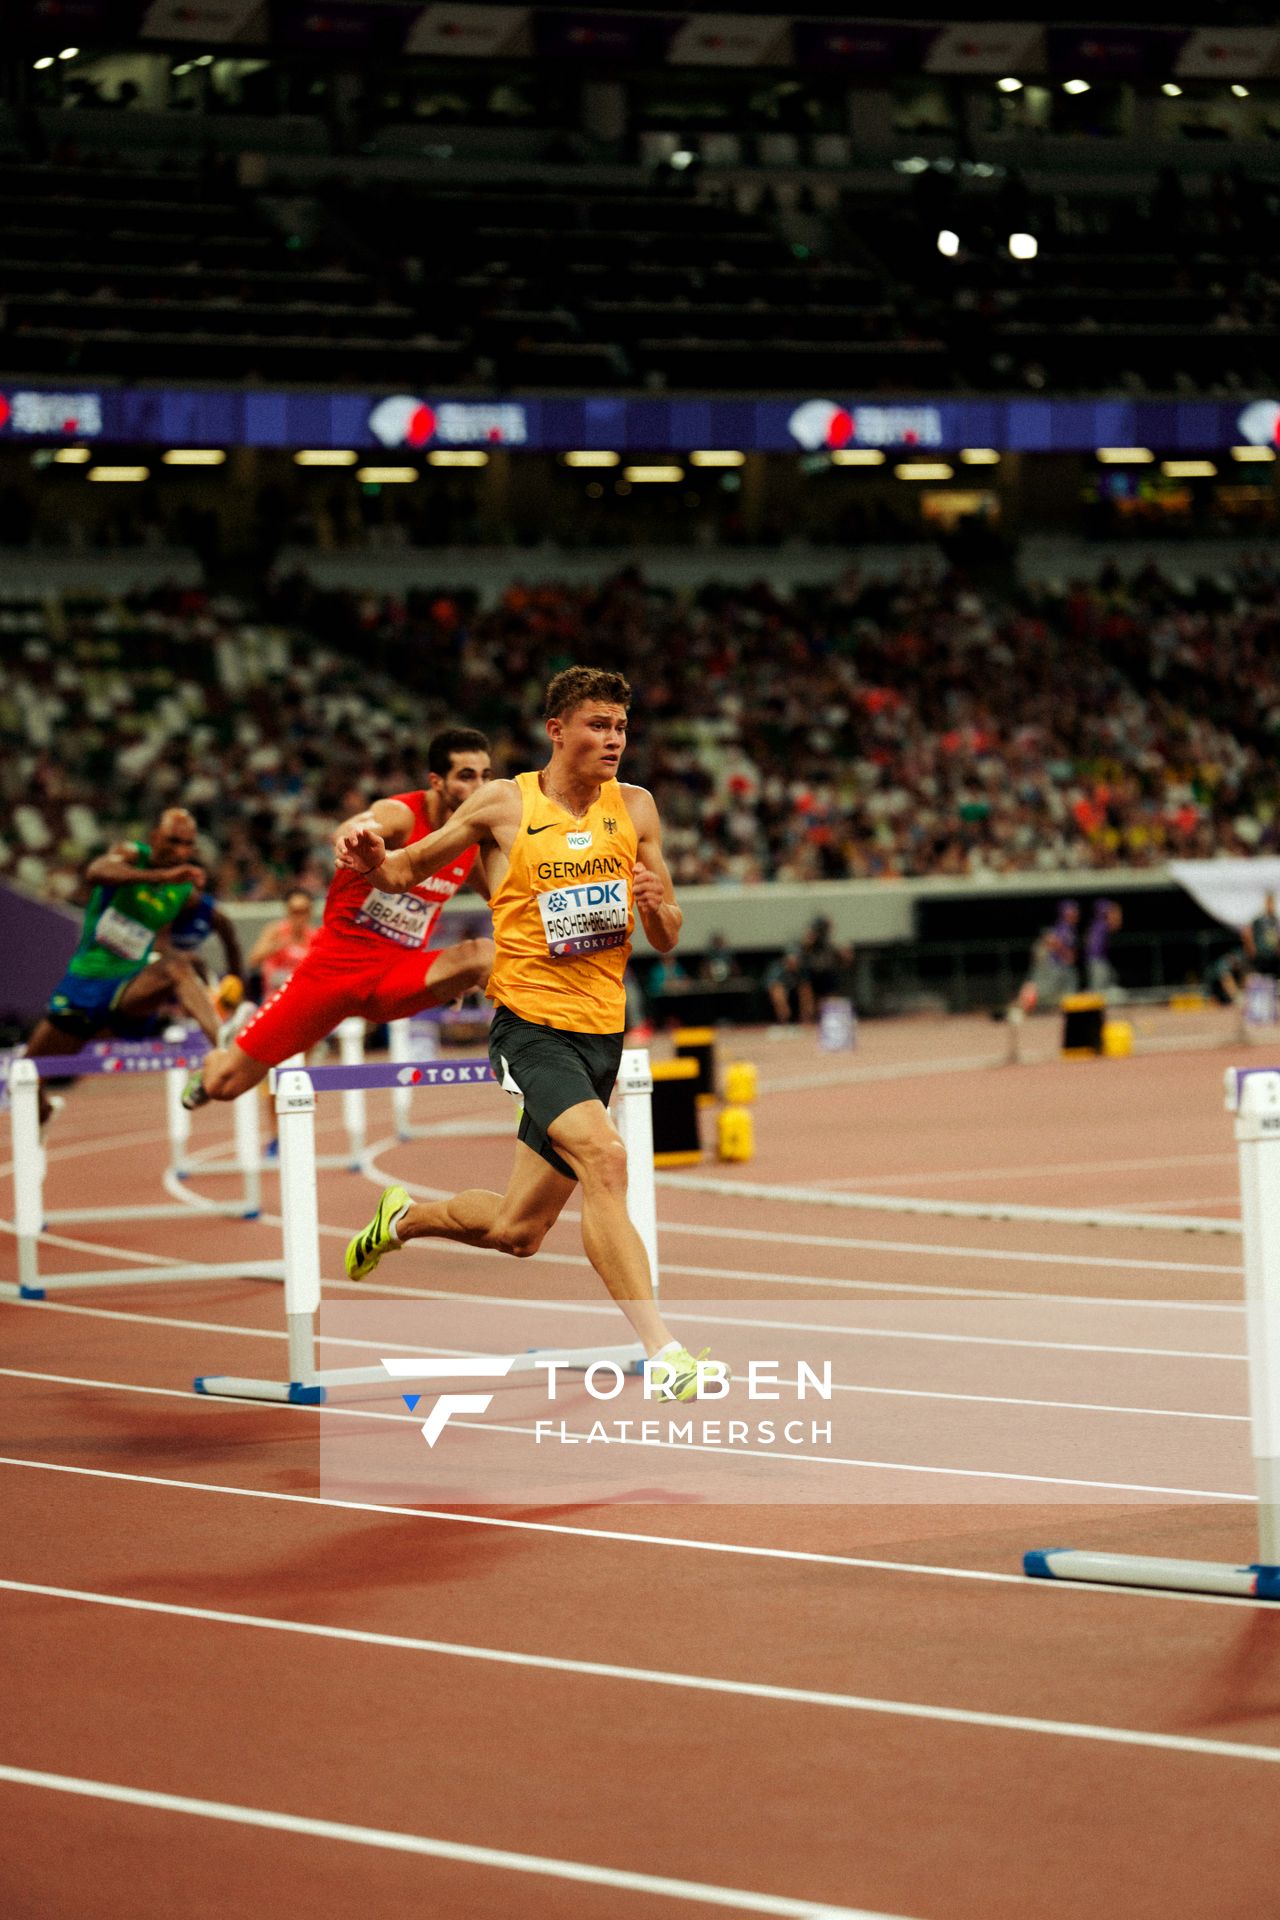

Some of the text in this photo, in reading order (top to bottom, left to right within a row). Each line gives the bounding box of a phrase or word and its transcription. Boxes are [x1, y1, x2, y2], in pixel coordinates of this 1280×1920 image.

[567, 835, 592, 846] WGV
[537, 857, 622, 880] GERMANY
[565, 882, 622, 908] TDK
